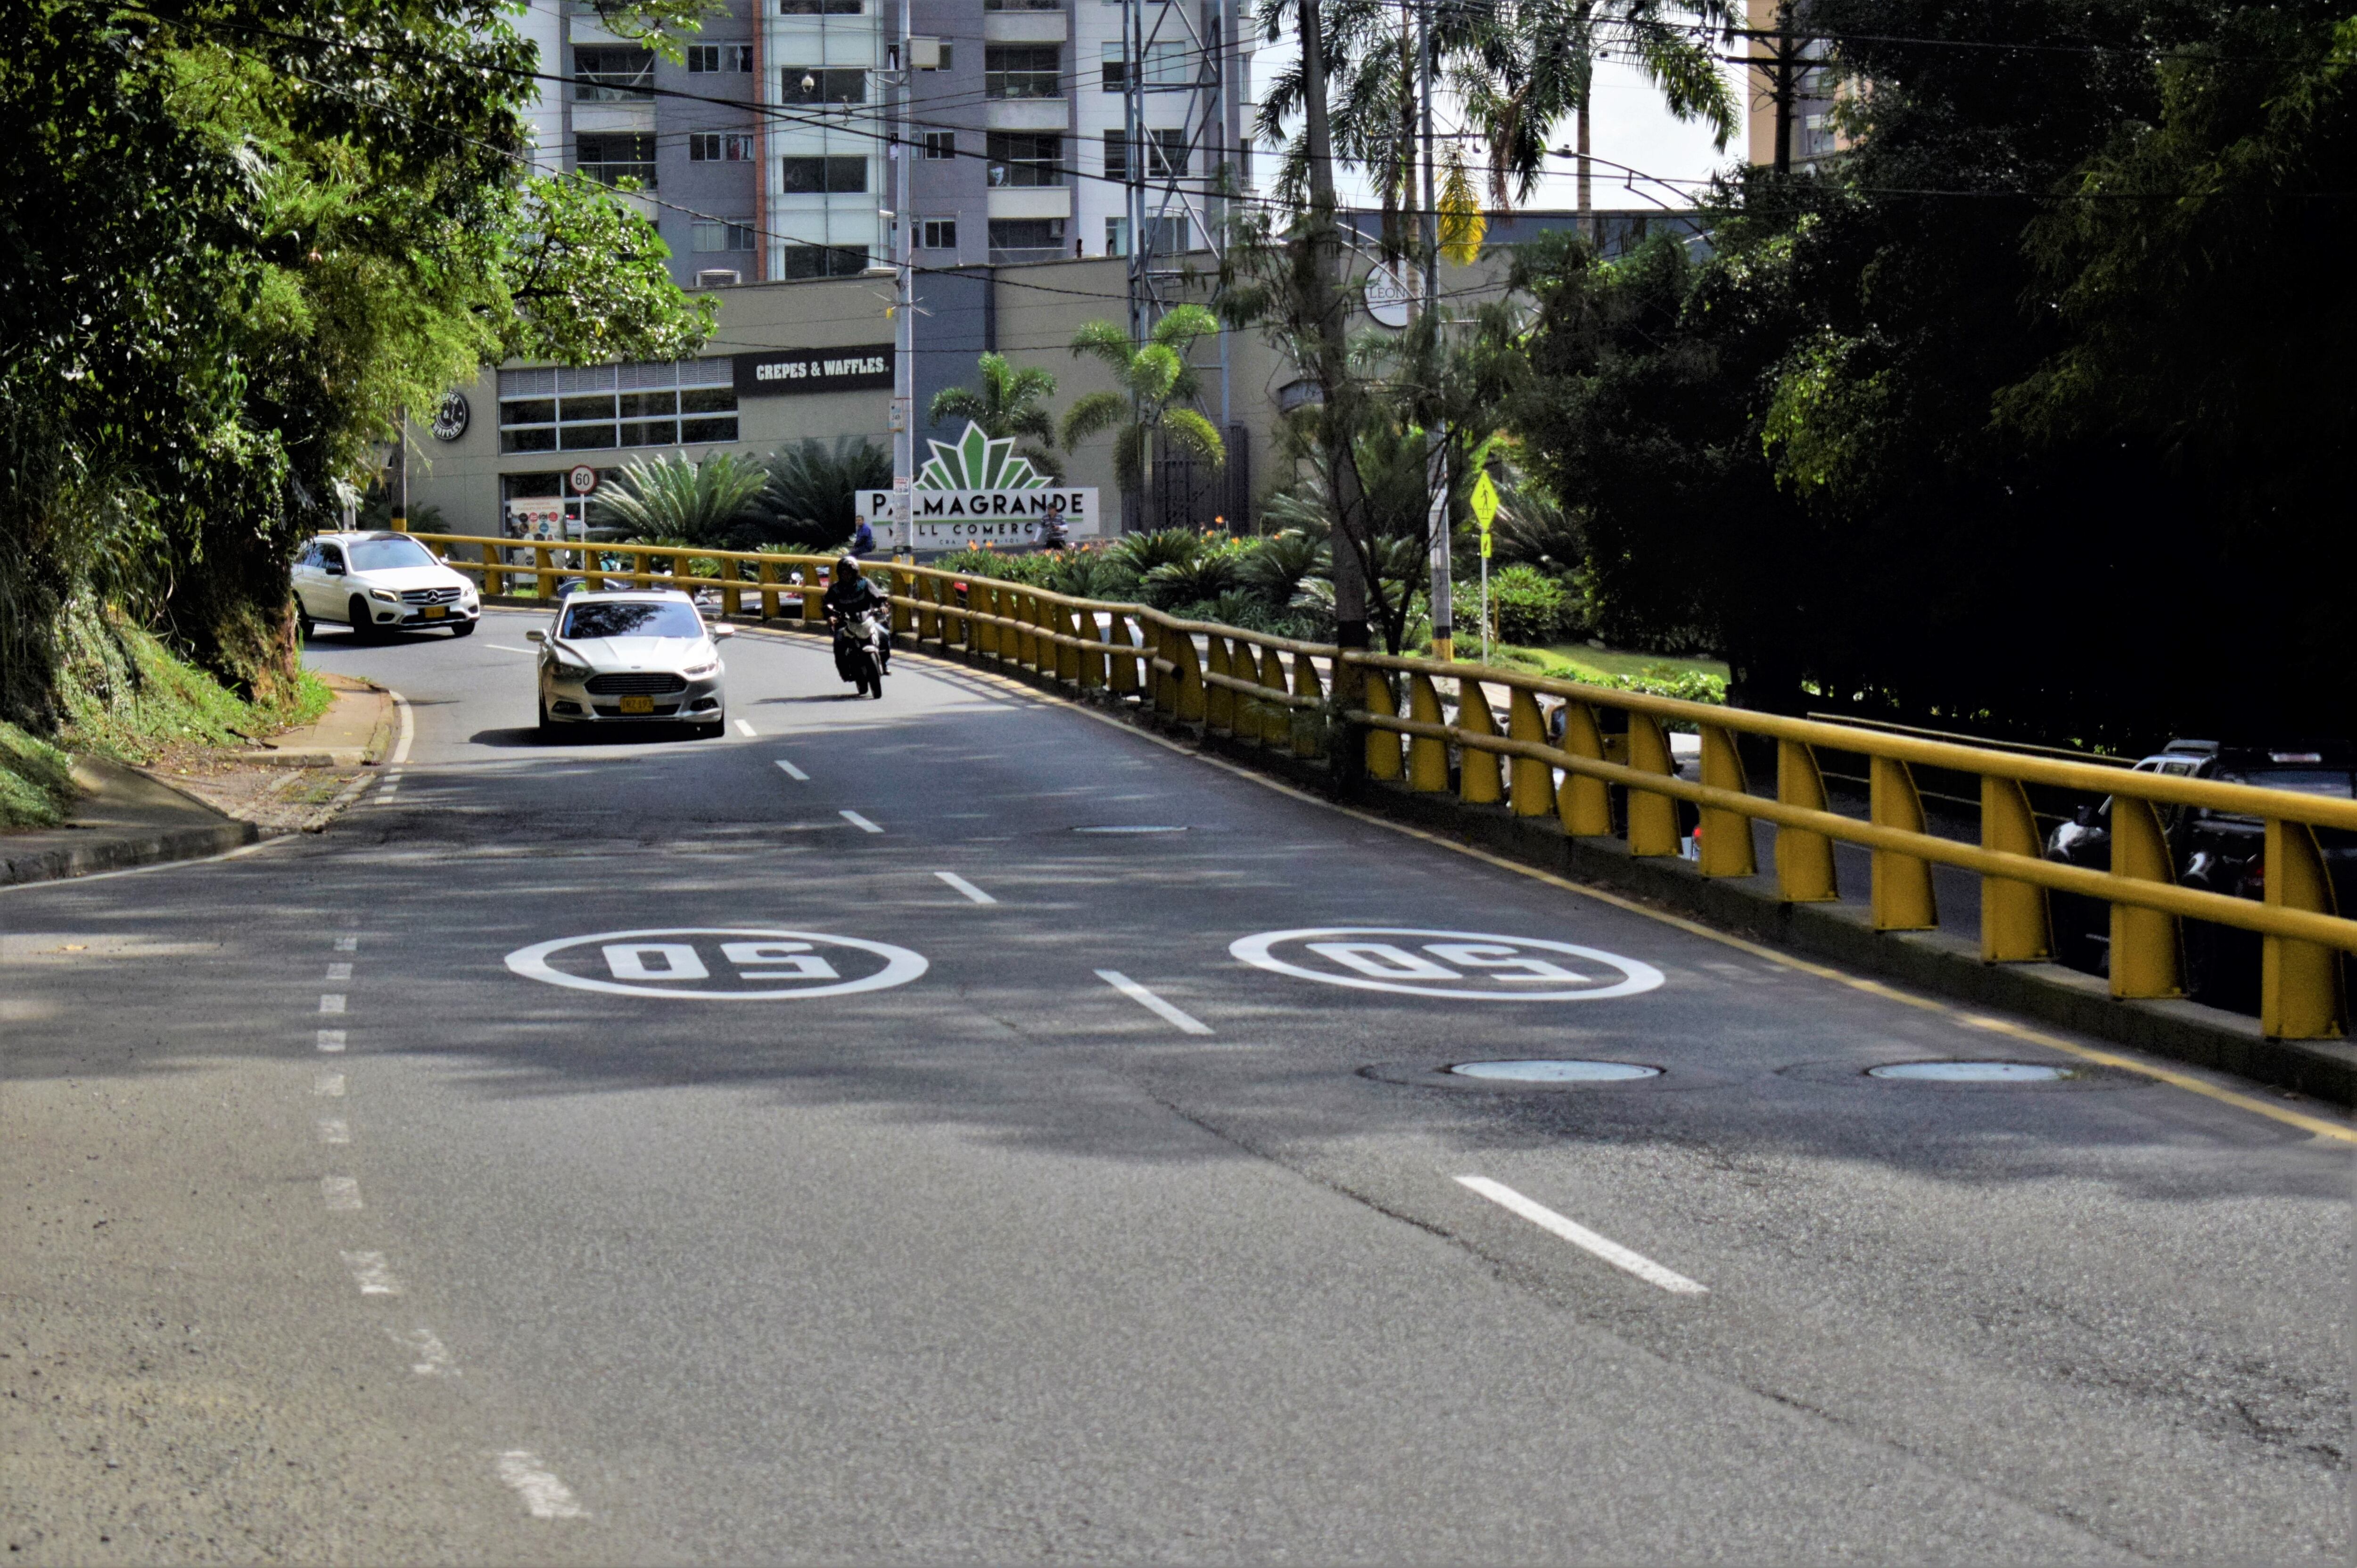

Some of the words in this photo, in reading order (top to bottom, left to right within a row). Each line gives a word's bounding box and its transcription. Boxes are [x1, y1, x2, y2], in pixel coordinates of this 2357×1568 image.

[1370, 287, 1425, 299] LEONR
[756, 363, 807, 380] CREPES
[810, 362, 821, 376] &
[824, 357, 884, 376] WAFFLES
[433, 421, 461, 437] WAFFLES
[576, 473, 590, 486] 60
[873, 493, 1083, 515] PMAGRANDE
[953, 523, 1033, 535] COMERC
[602, 941, 840, 980] 50
[1305, 943, 1591, 982] 50
